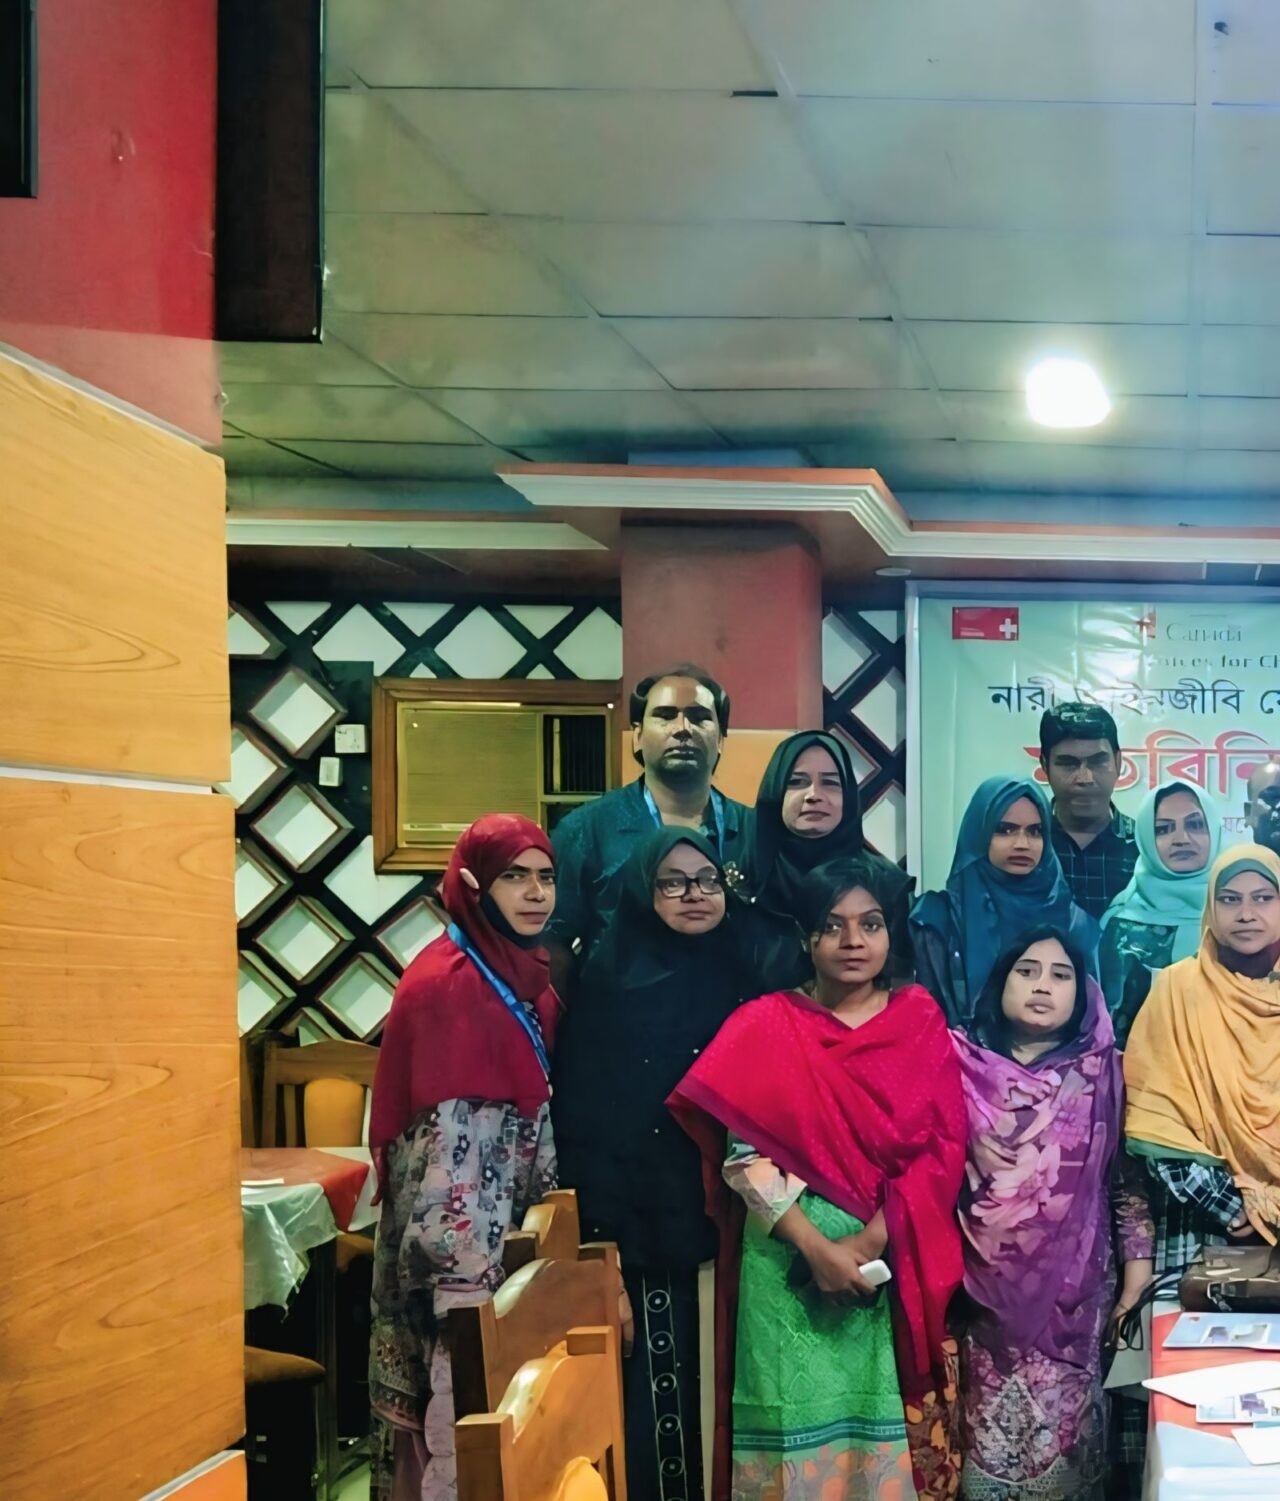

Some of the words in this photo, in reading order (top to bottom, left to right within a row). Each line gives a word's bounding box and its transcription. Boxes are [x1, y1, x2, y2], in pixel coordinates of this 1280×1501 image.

[1165, 622, 1242, 642] Canada
[1149, 653, 1214, 668] oices
[1221, 655, 1252, 669] for
[987, 676, 1056, 713] নারী
